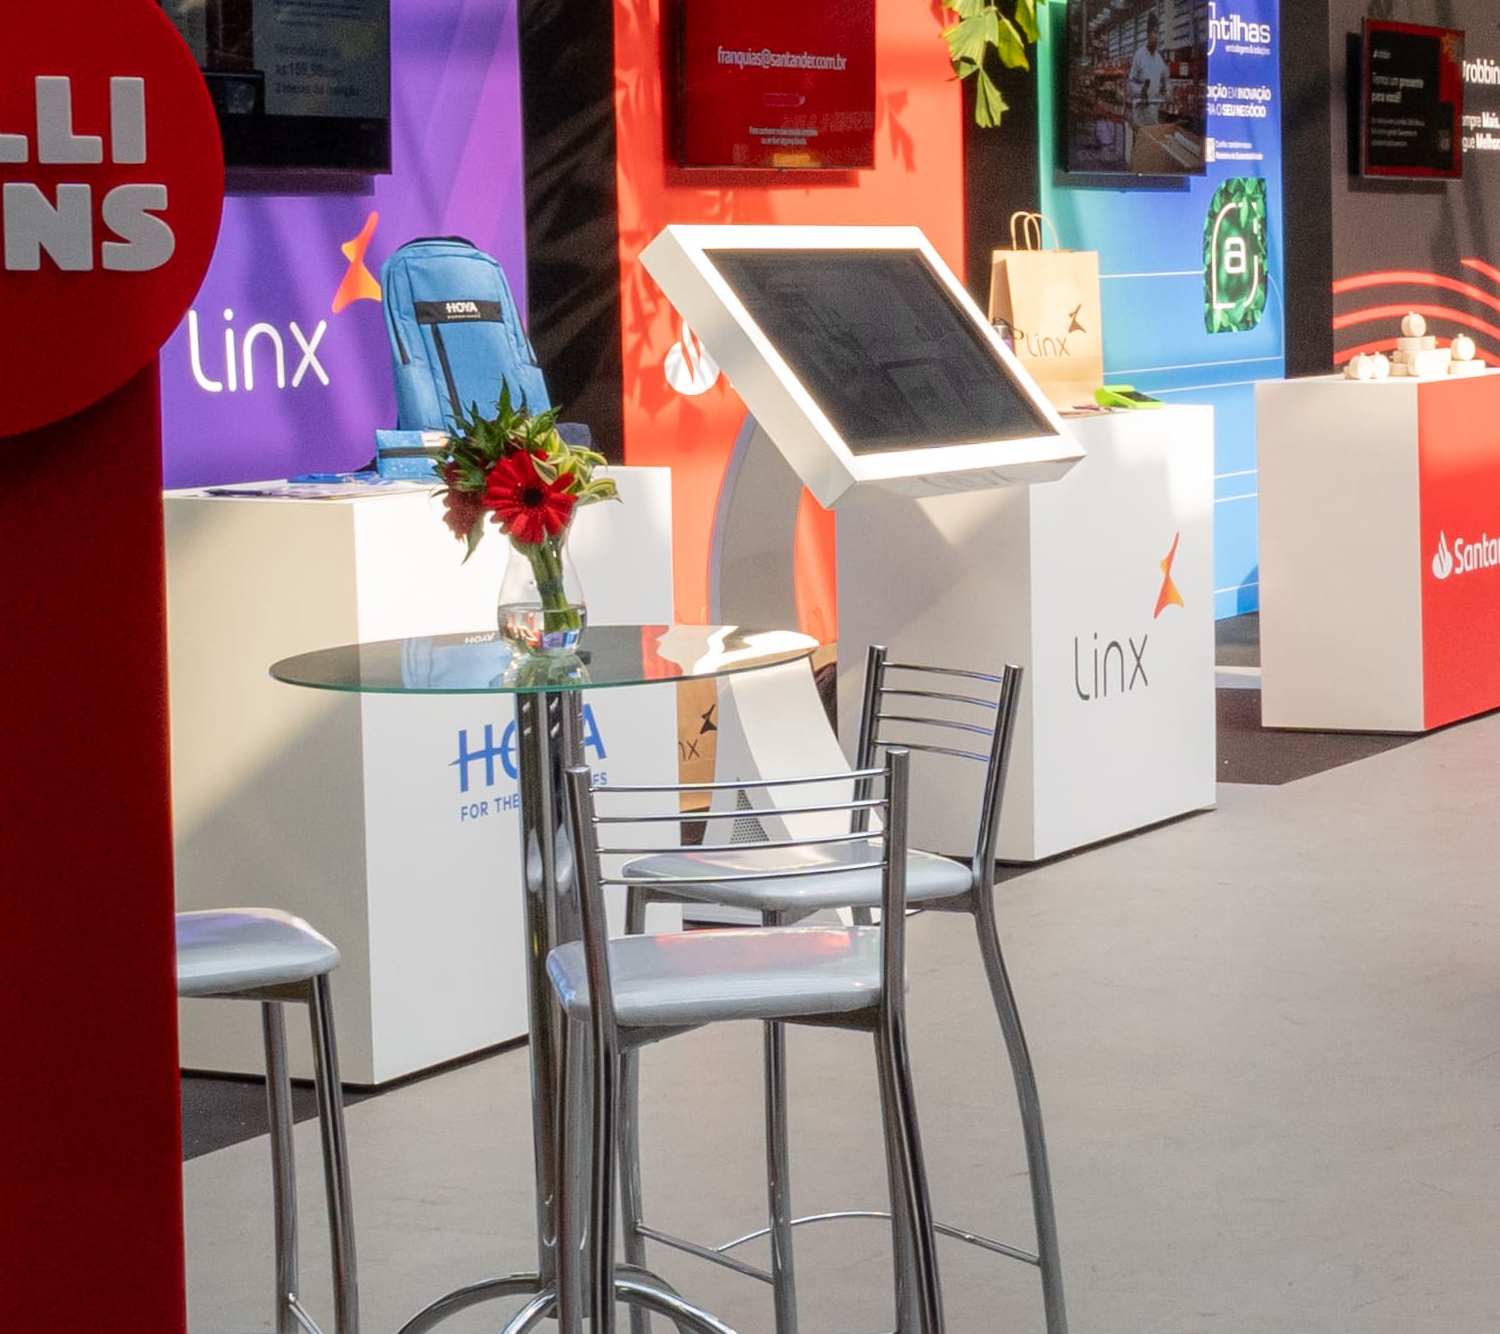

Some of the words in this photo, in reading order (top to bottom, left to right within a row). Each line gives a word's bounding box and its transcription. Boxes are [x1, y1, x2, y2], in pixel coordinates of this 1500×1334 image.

[717, 45, 847, 71] franquias@santander.com.br
[1465, 58, 1500, 85] robbin
[445, 301, 479, 314] HOYA
[460, 799, 489, 822] FOR
[494, 792, 520, 812] THE
